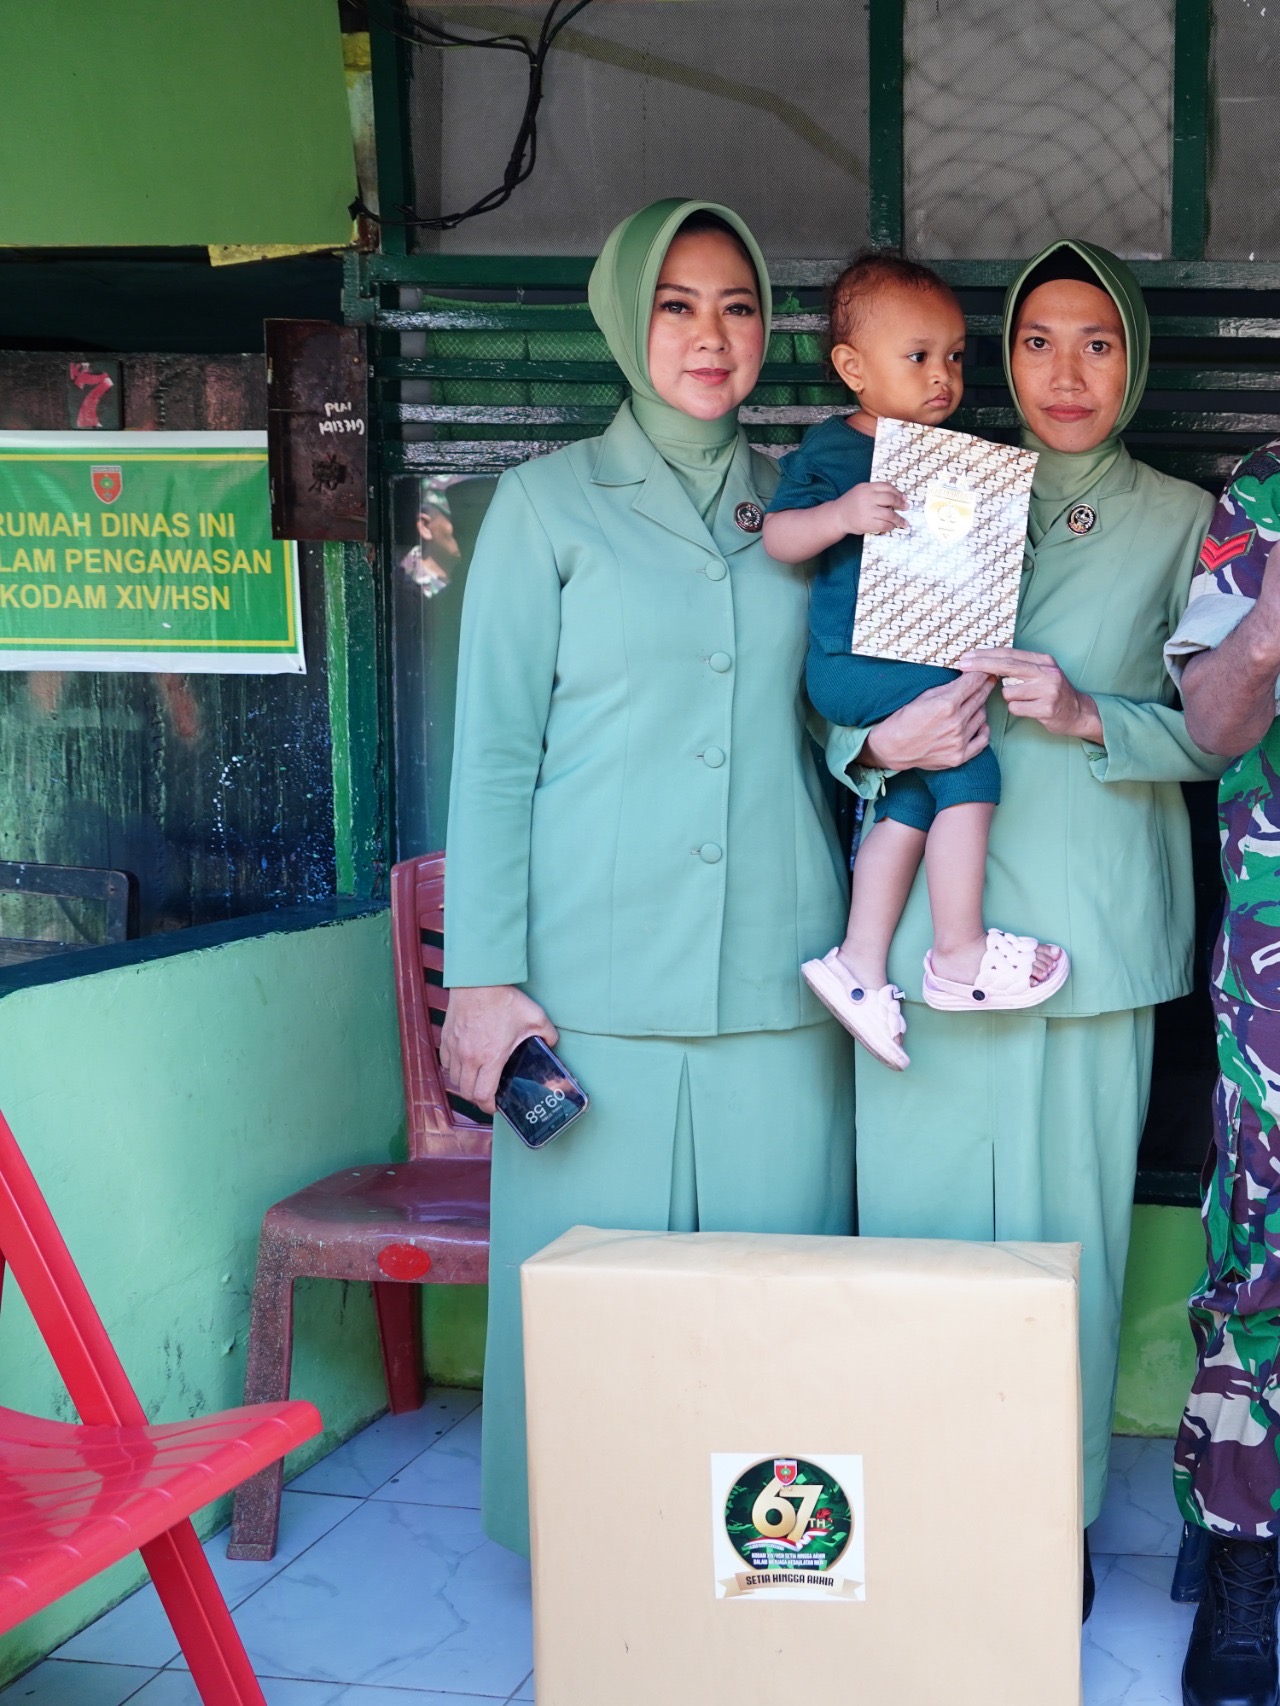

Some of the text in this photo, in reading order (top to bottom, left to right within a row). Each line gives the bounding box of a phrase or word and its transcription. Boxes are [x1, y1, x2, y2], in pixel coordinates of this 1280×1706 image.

[70, 362, 114, 428] 7
[102, 512, 190, 537] DINAS
[200, 513, 235, 538] INI
[66, 548, 272, 574] PENGAWASAN
[0, 584, 230, 610] KODAM XIV/HSN
[525, 1088, 566, 1124] 09.58
[746, 1574, 771, 1585] SETIA
[772, 1573, 805, 1583] HINGGA
